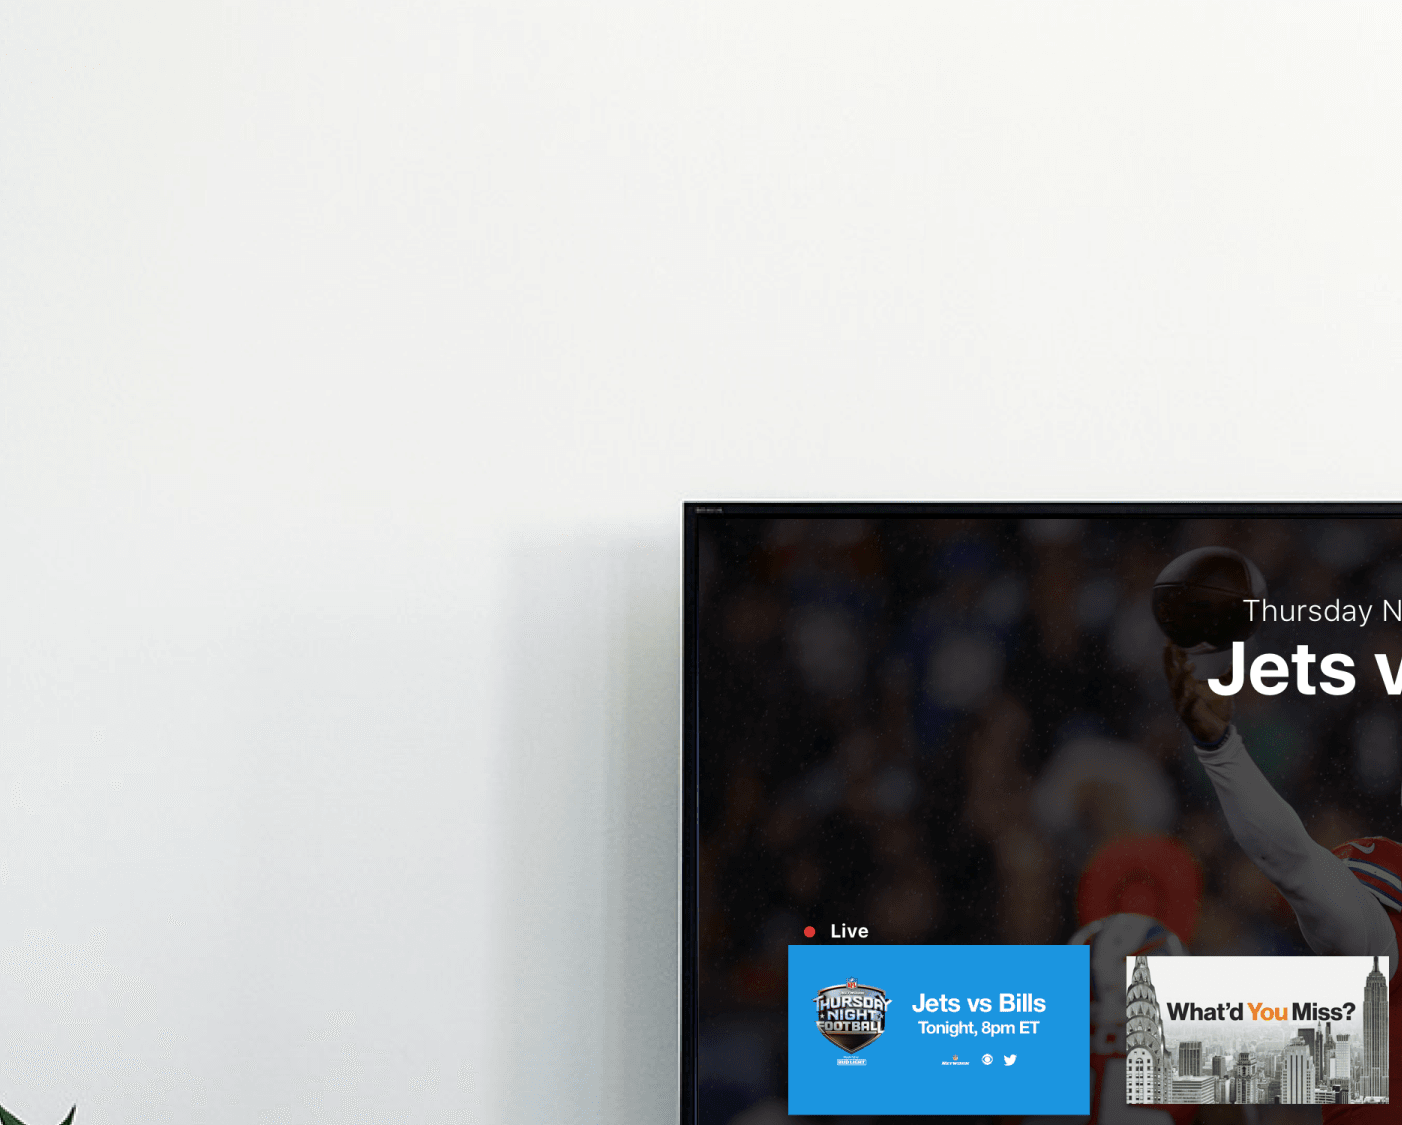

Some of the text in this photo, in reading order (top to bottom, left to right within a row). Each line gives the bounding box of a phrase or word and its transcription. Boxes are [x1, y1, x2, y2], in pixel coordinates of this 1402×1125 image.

[1243, 598, 1373, 628] Thursday
[1207, 641, 1356, 696] Jets
[831, 923, 869, 939] Live
[812, 993, 893, 1012] THURSDAY
[912, 993, 1047, 1013] Jets vs Bills
[1247, 1002, 1288, 1021] You
[1292, 1002, 1356, 1021] Miss?
[827, 1009, 877, 1021] NIGHT
[815, 1020, 885, 1034] FOOTBALL
[917, 1020, 1041, 1038] Tonight, 8pm ET
